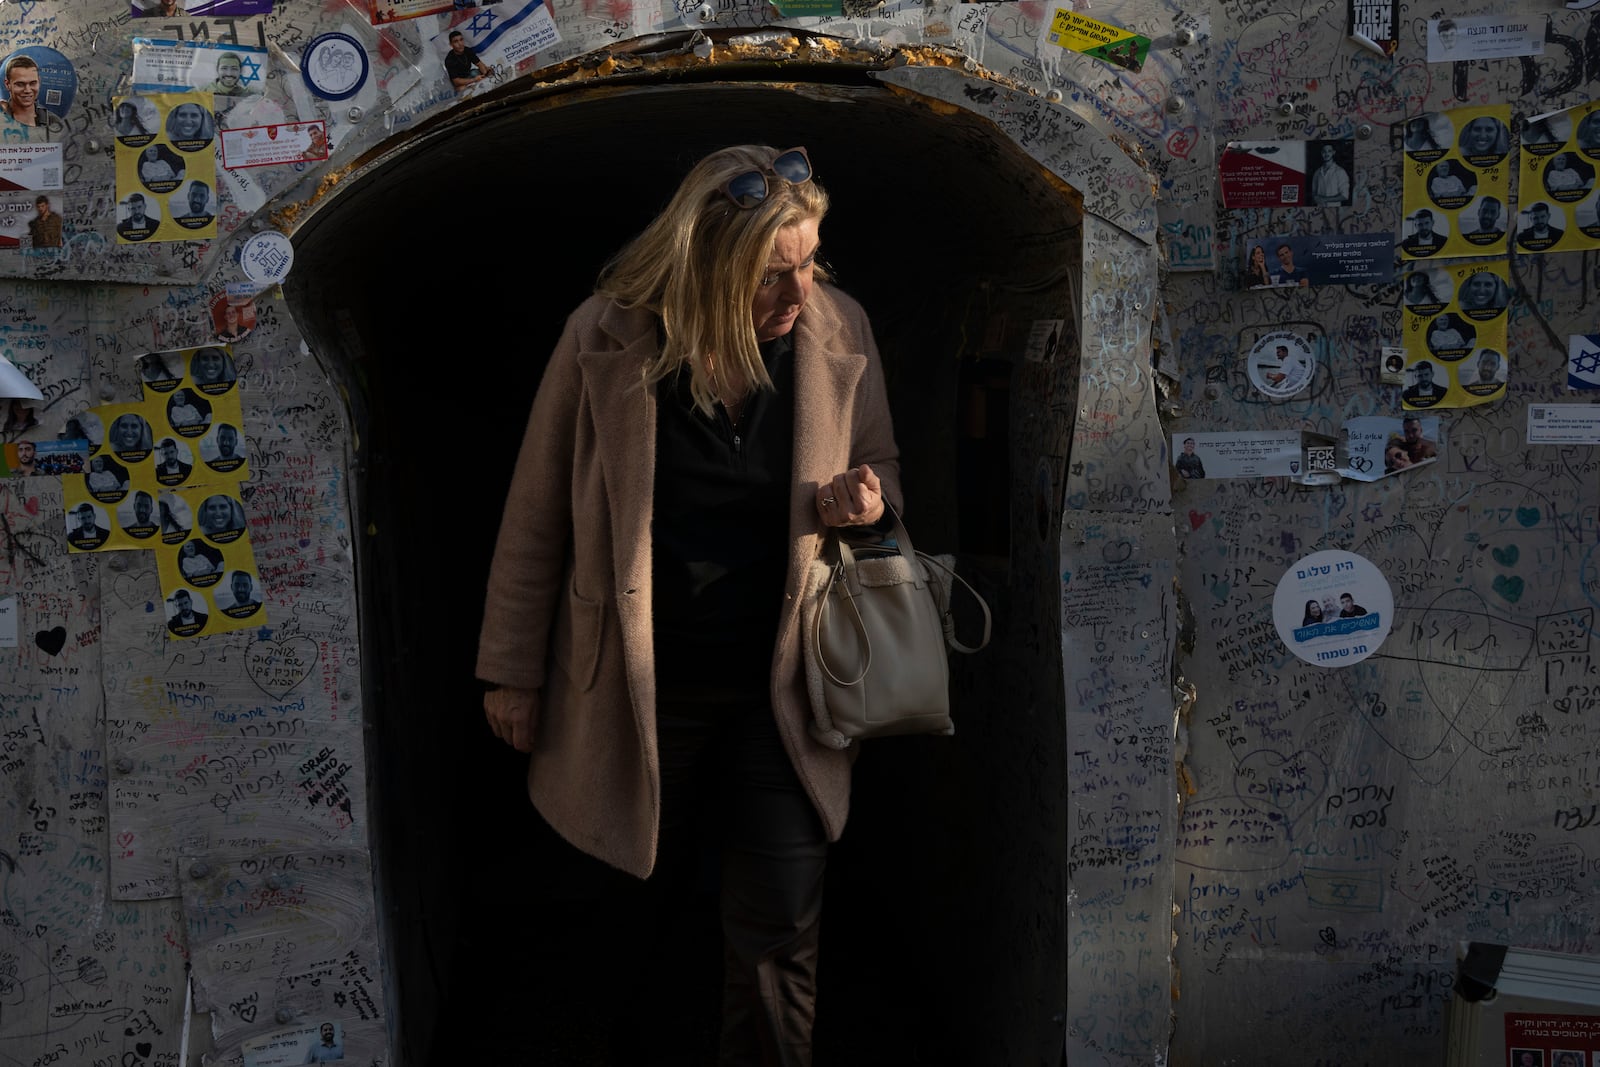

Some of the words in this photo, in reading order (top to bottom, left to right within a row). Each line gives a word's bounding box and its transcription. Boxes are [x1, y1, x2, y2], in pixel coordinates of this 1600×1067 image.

[1353, 6, 1392, 24] THEM
[1352, 24, 1392, 41] HOME
[1467, 26, 1486, 36] מנצח
[1489, 25, 1504, 34] דור
[1506, 24, 1528, 32] אנחנו
[8, 201, 33, 212] לוחם
[2, 216, 16, 226] לא
[1344, 264, 1368, 272] 7.10.23
[1307, 450, 1334, 460] FCK
[1307, 460, 1336, 470] HMS
[211, 530, 239, 538] KIDNAPPED
[1336, 560, 1354, 572] היו
[191, 574, 217, 582] KIDNAPPED
[228, 605, 256, 614] KIDNAPPED
[175, 623, 200, 632] KIDNAPPED
[1322, 624, 1337, 634] את
[1216, 635, 1235, 651] NYC
[1353, 644, 1368, 654] חג
[266, 646, 296, 658] עומר
[1218, 644, 1244, 663] WITH
[1317, 648, 1350, 662] שמח!
[1228, 649, 1274, 675] ALWAYS
[1235, 699, 1280, 714] Bring
[299, 747, 336, 775] ISRAEL
[1074, 750, 1099, 770] The
[1108, 748, 1129, 767] US
[300, 777, 316, 791] TE
[316, 757, 338, 780] AMO
[308, 790, 324, 807] AM
[1327, 784, 1394, 814] מחכים
[1349, 803, 1392, 829] לכם
[1422, 854, 1450, 870] From
[1190, 872, 1240, 902] bring
[346, 950, 359, 966] No
[349, 989, 369, 1021] home
[354, 979, 380, 1019] everyone
[1536, 1020, 1558, 1030] דורון
[1522, 1029, 1550, 1038] בעזה.
[1552, 1030, 1588, 1038] חטופים
